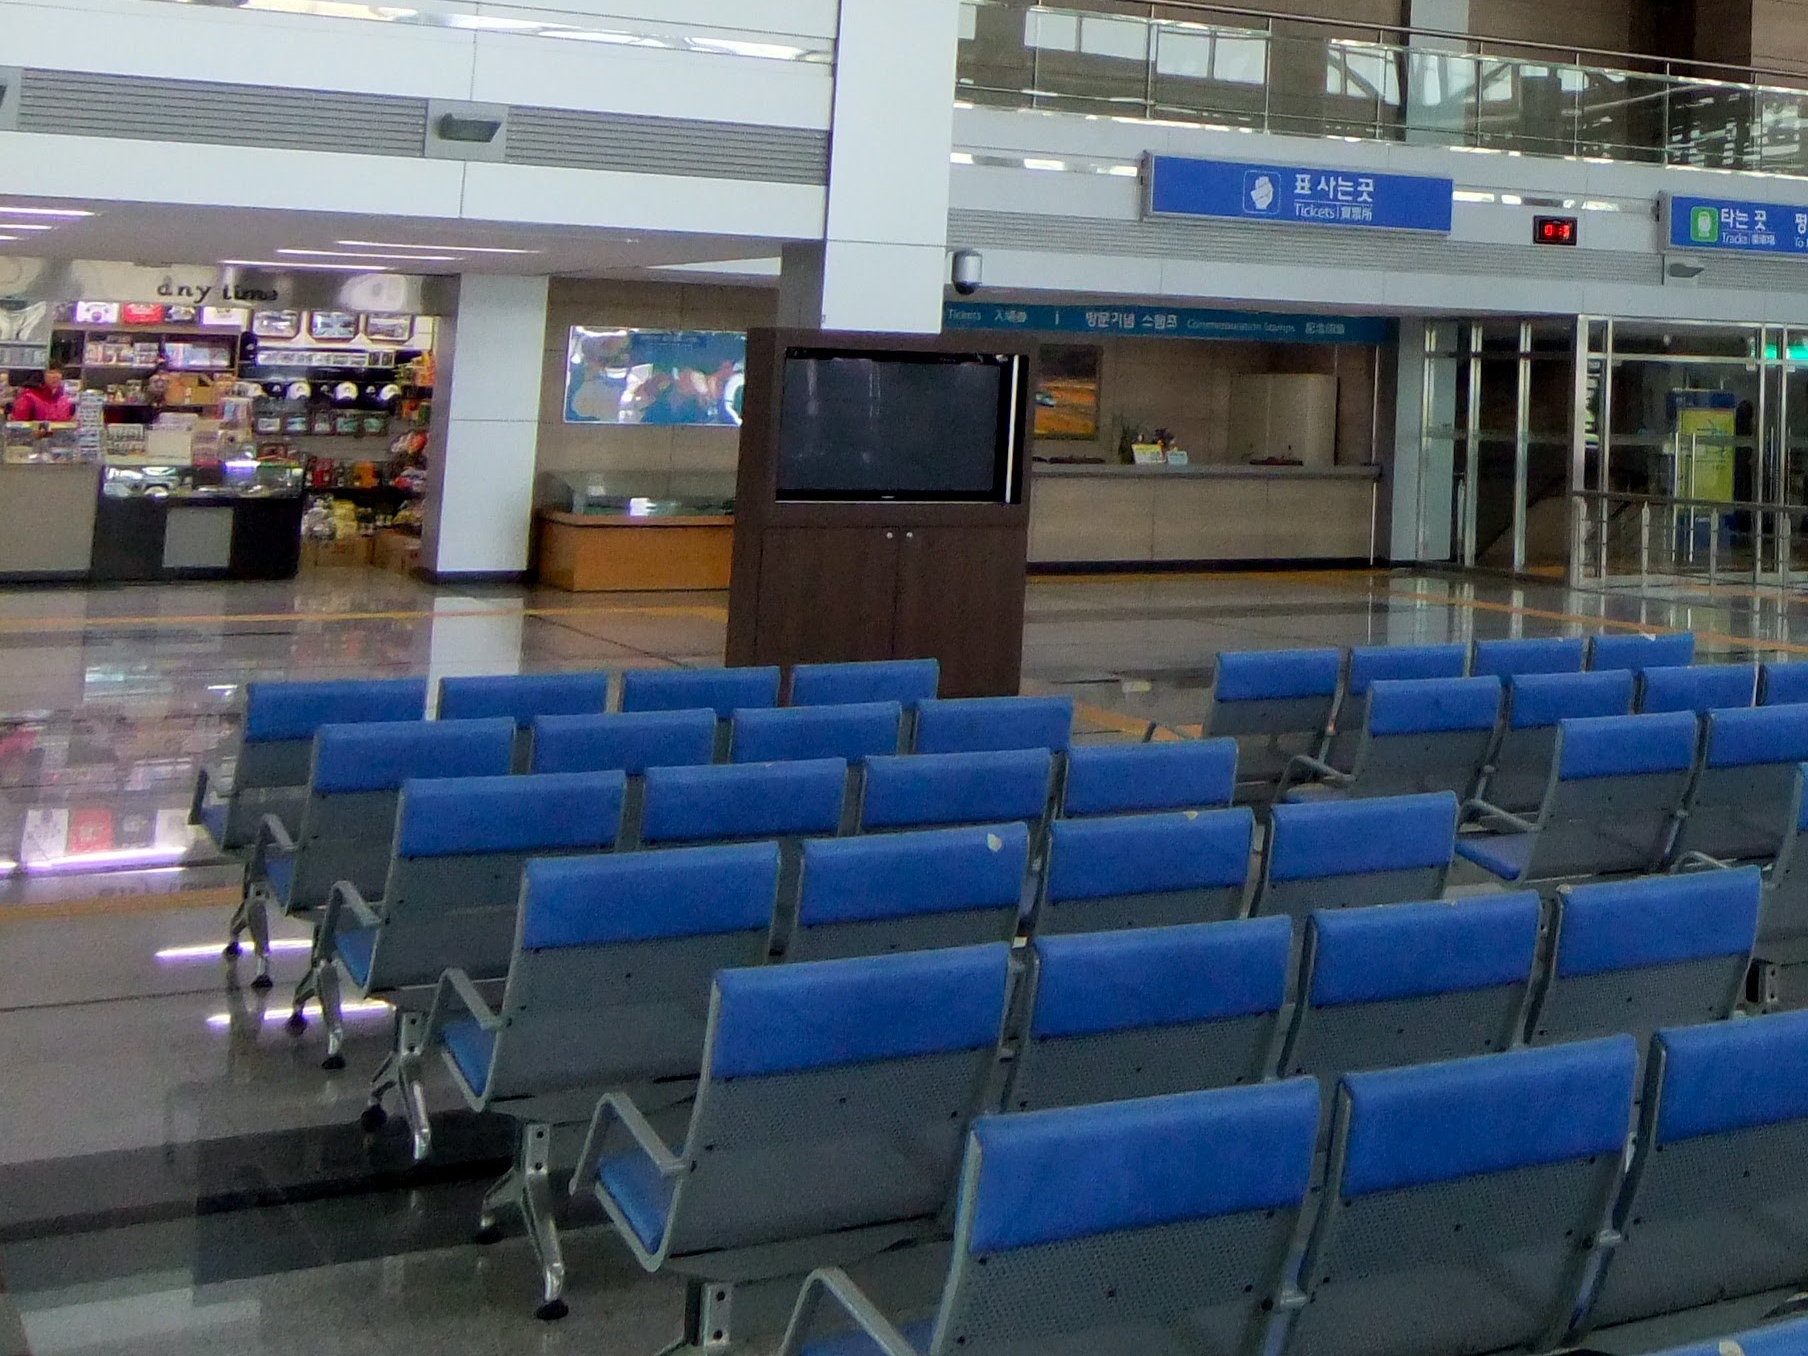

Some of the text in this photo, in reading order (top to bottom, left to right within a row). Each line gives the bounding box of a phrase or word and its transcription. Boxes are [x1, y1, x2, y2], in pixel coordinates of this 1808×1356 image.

[1294, 173, 1312, 195] 표
[1295, 202, 1335, 219] Tickets
[1721, 208, 1767, 230] 타는 곳
[1794, 236, 1804, 248] To
[1085, 311, 1135, 328] 방문기념
